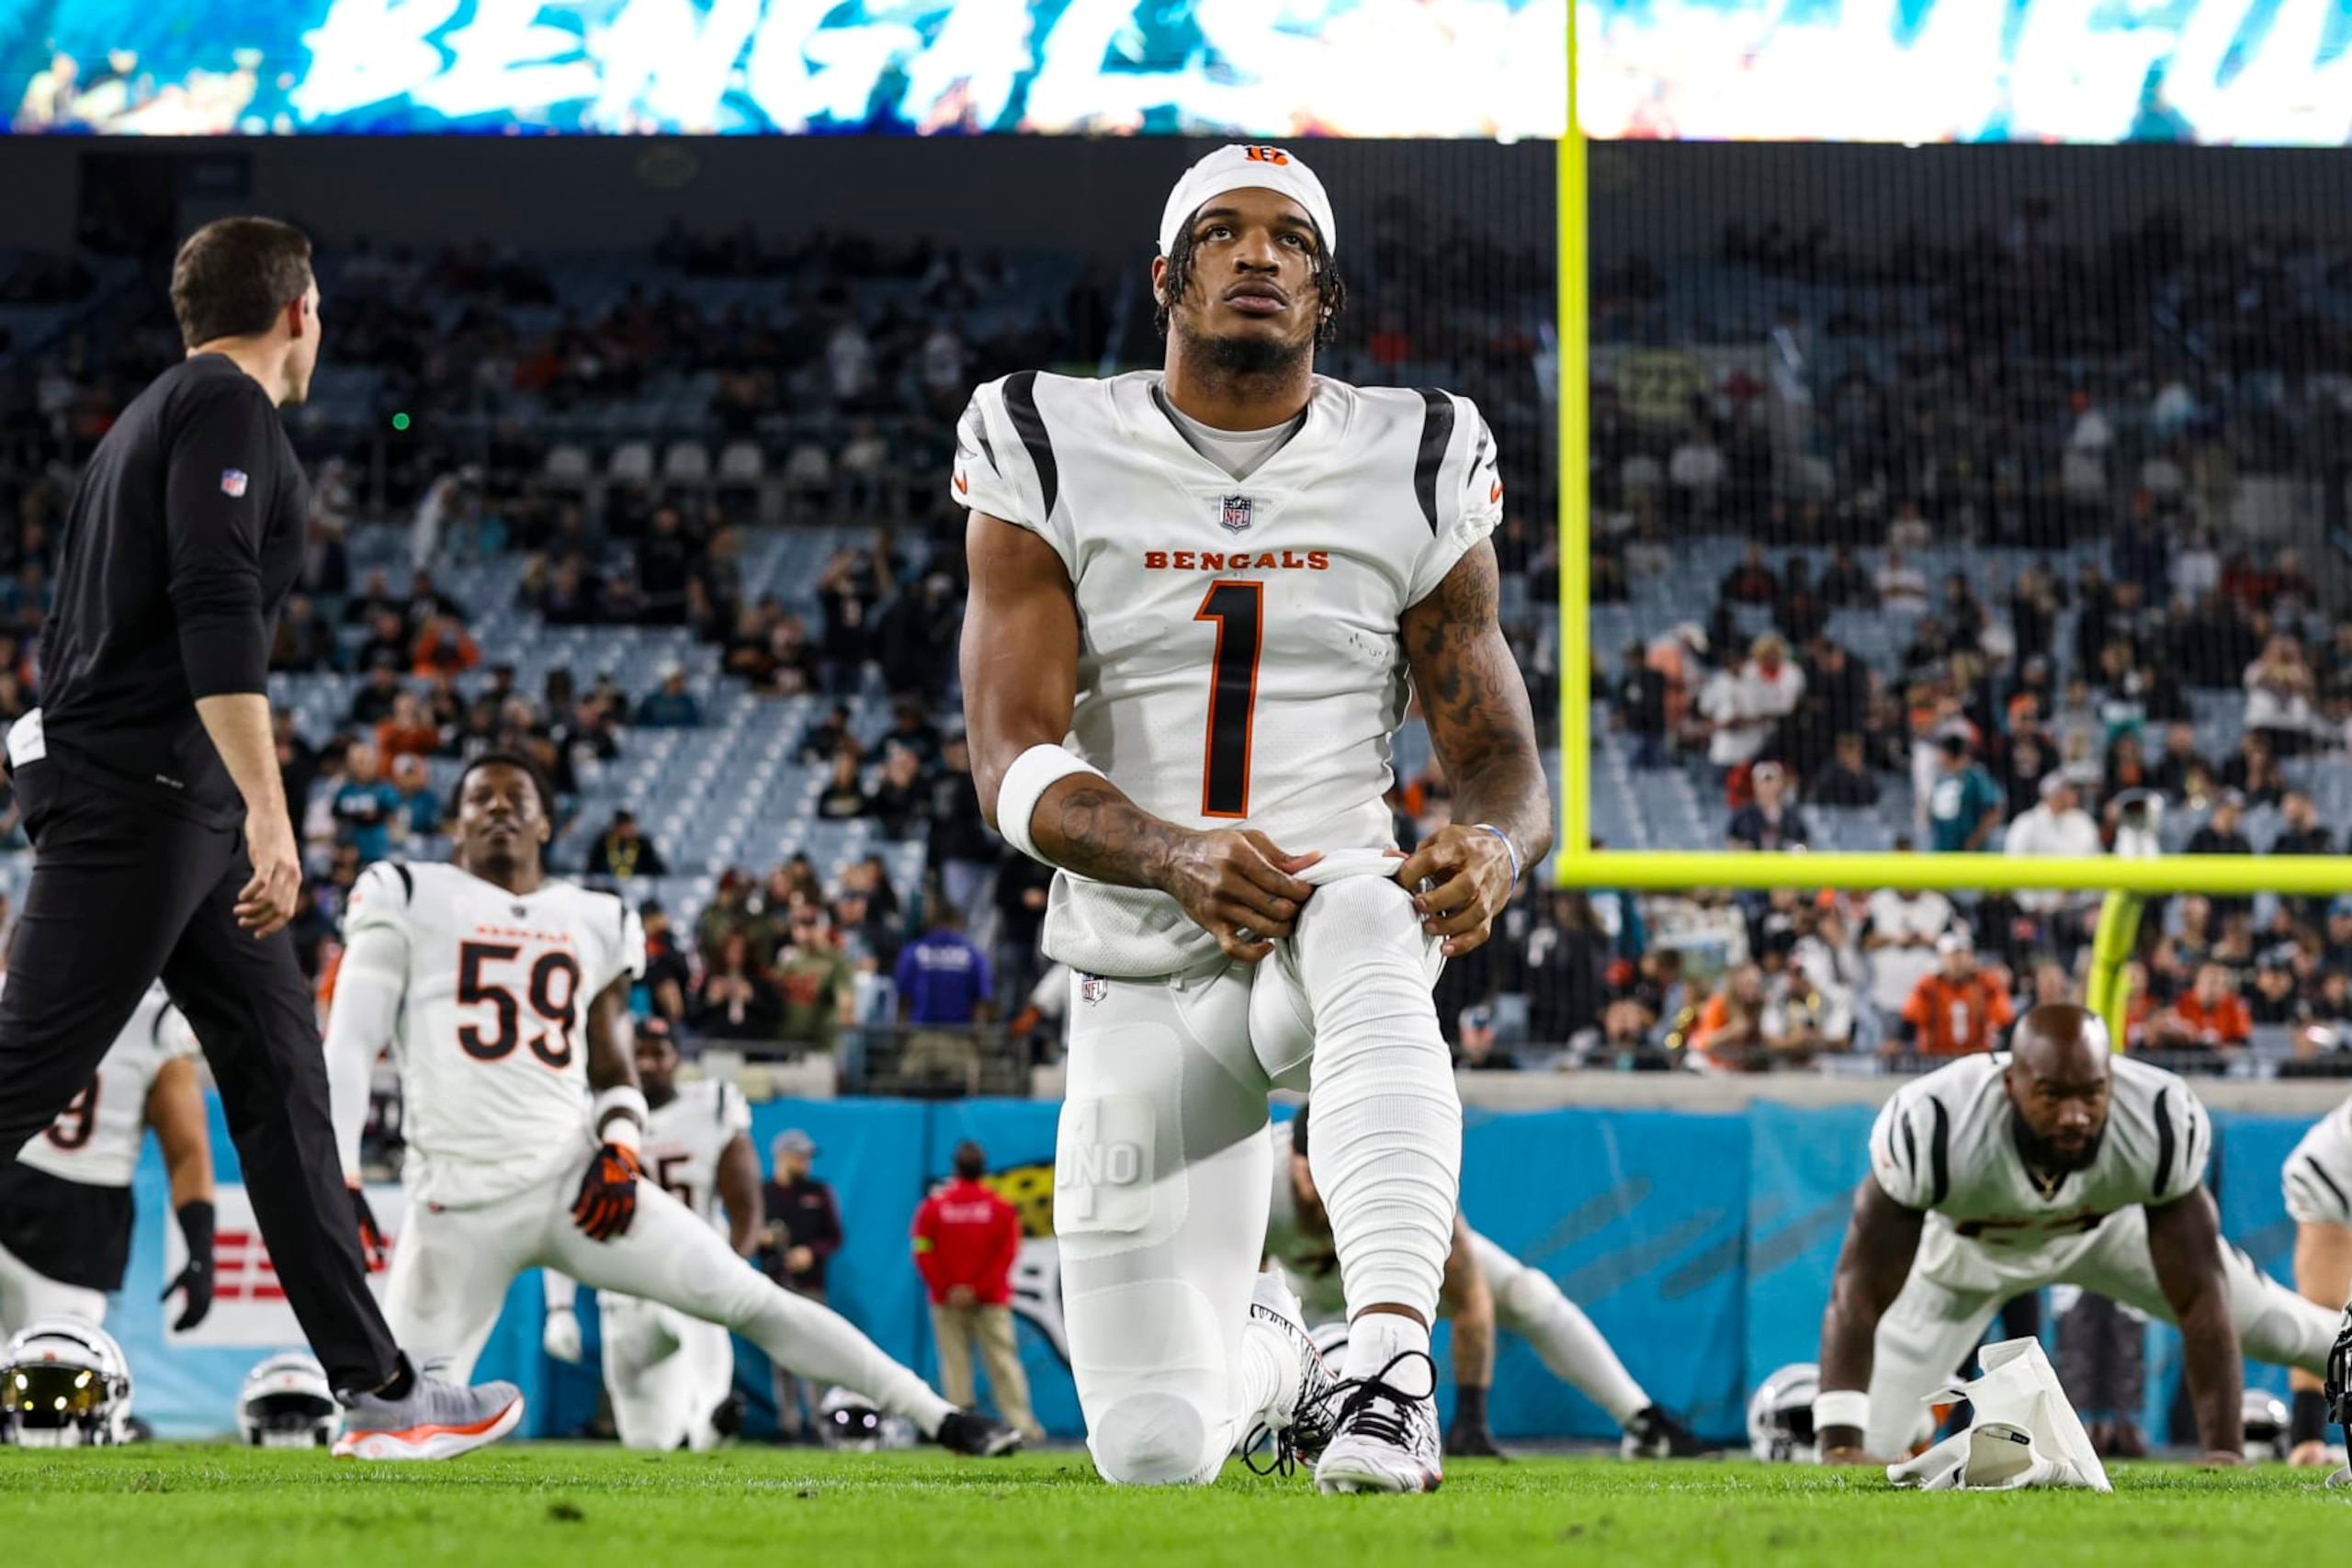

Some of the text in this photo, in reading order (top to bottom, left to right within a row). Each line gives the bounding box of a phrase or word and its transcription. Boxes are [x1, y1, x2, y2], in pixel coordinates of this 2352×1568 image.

[1224, 509, 1249, 525] NFL
[1144, 550, 1329, 571] BENGALS
[1193, 581, 1264, 819] 1
[456, 940, 582, 1070] 59
